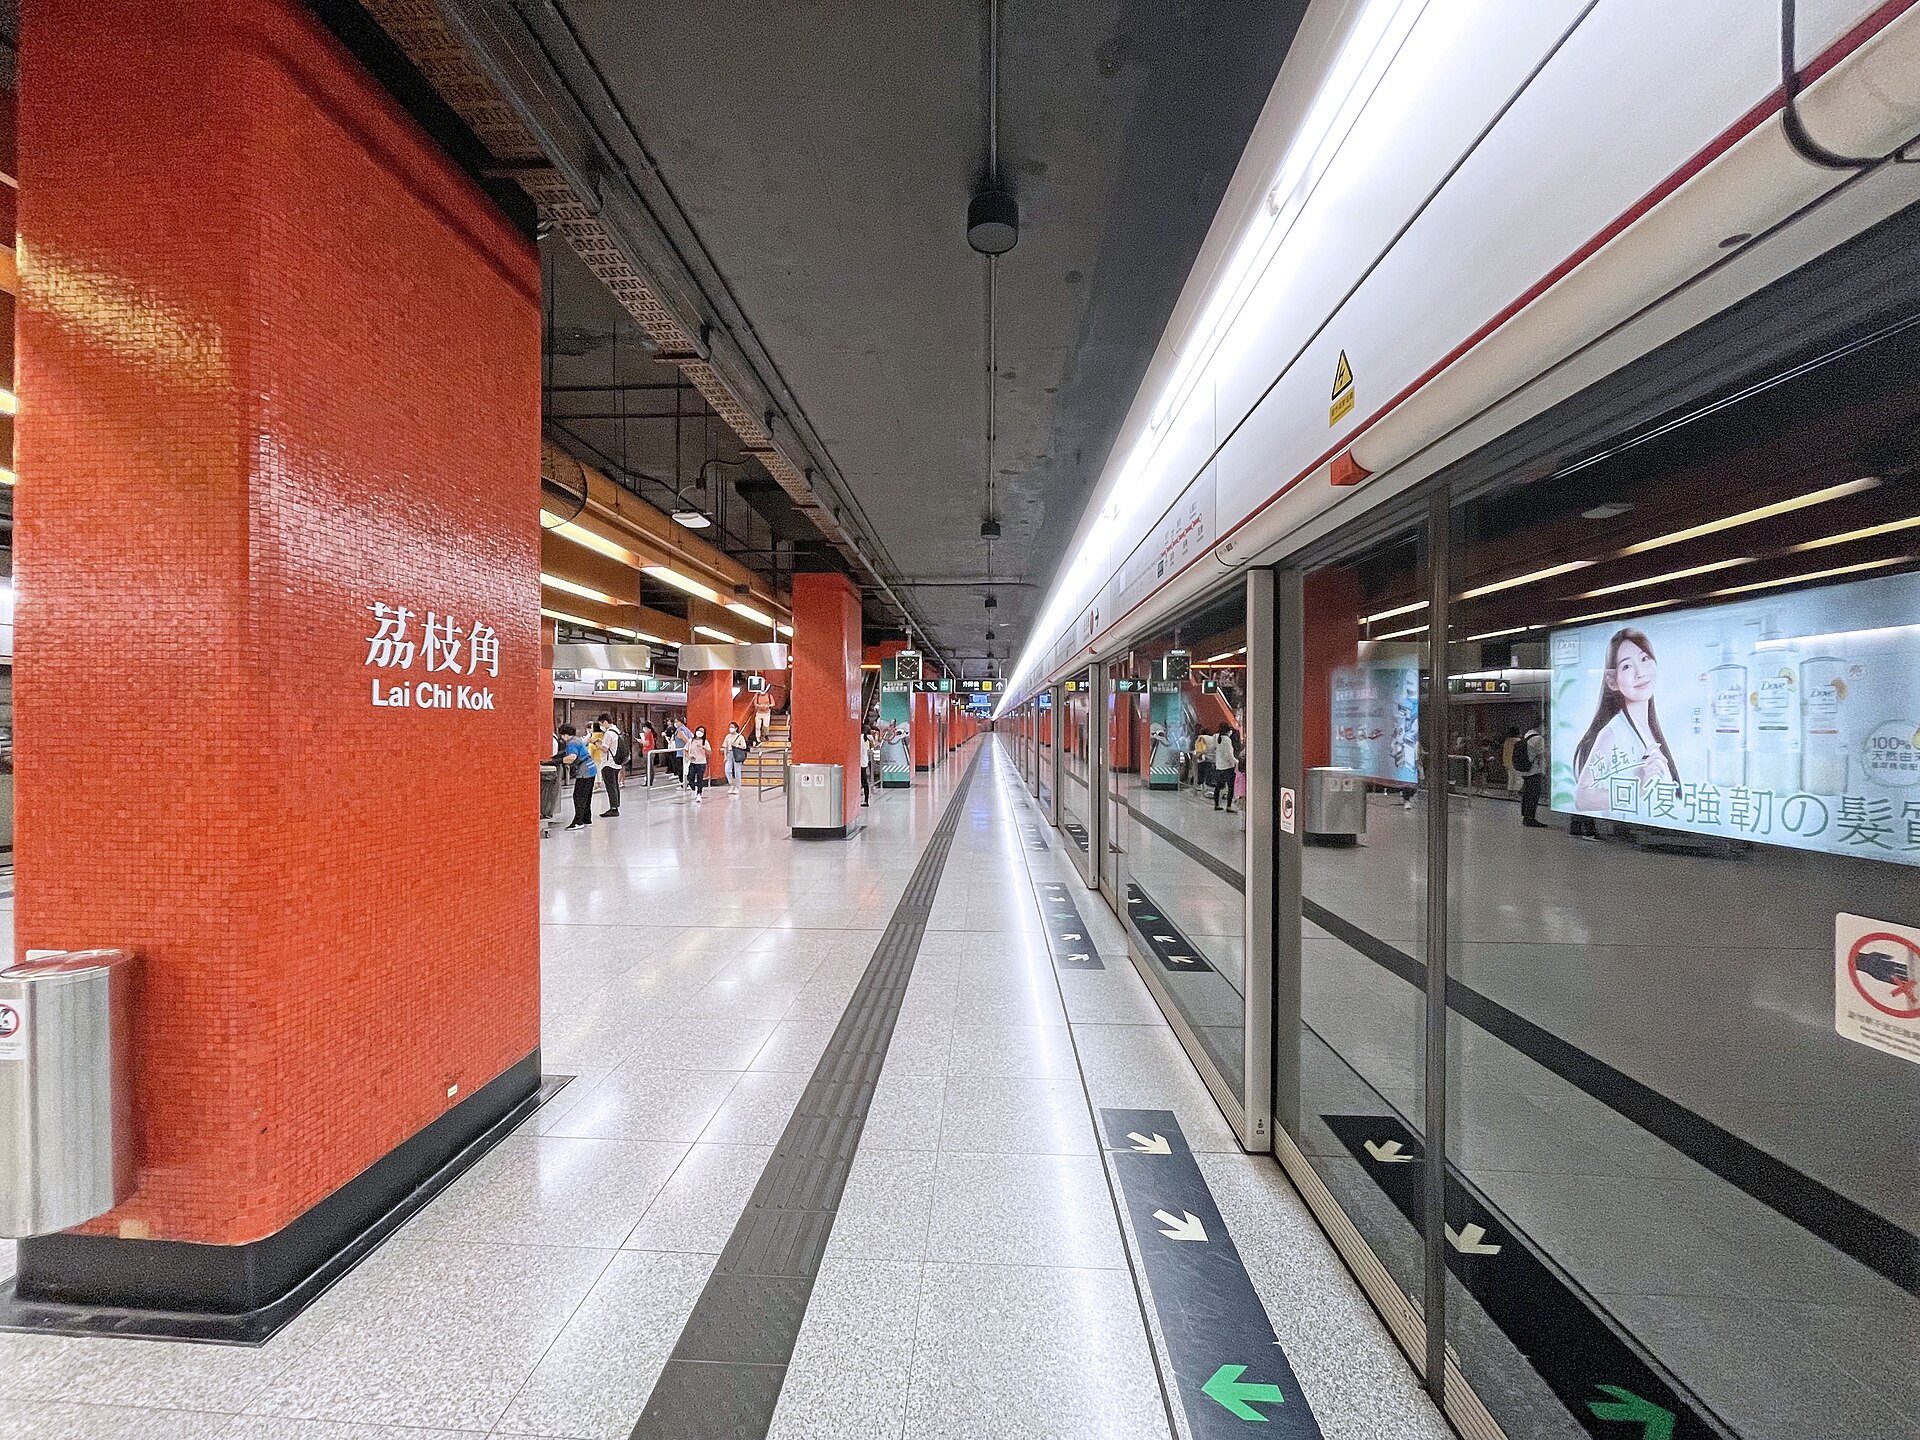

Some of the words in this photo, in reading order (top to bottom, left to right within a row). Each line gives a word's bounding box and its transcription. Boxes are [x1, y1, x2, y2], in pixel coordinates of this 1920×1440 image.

[364, 601, 500, 678] 荔枝角
[372, 678, 410, 707] Lai
[415, 682, 452, 708] Chi
[457, 685, 495, 711] Kok
[1761, 680, 1786, 690] Dove
